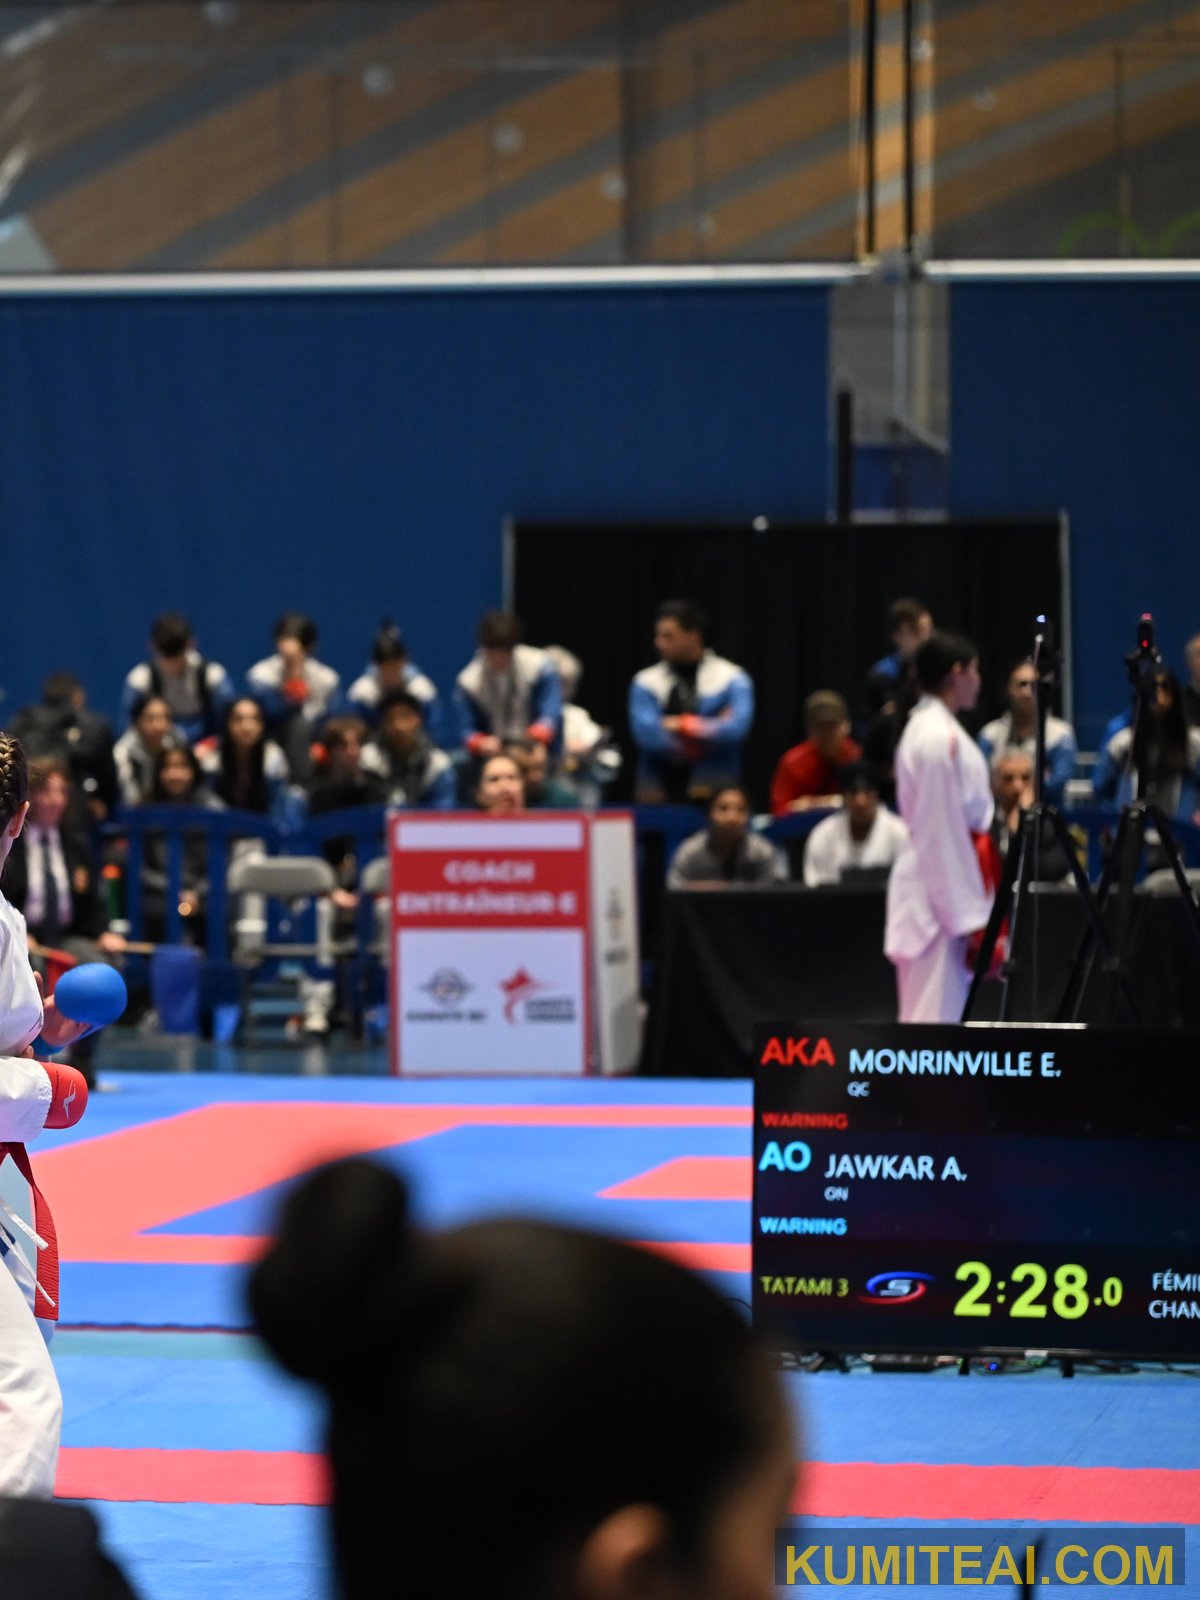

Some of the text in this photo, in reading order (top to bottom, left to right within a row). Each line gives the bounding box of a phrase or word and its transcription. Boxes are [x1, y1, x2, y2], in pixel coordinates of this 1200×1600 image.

[760, 1036, 836, 1067] AKA
[849, 1048, 1062, 1078] MONRINVILLE E.
[847, 1081, 870, 1098] QC
[761, 1112, 849, 1130] WARNING
[758, 1140, 812, 1173] AO
[824, 1153, 968, 1182] JAWKAR A.
[823, 1186, 849, 1201] ON
[759, 1216, 848, 1236] WARNING
[760, 1275, 849, 1297] TATAMI 3
[1152, 1268, 1200, 1292] FÉMI
